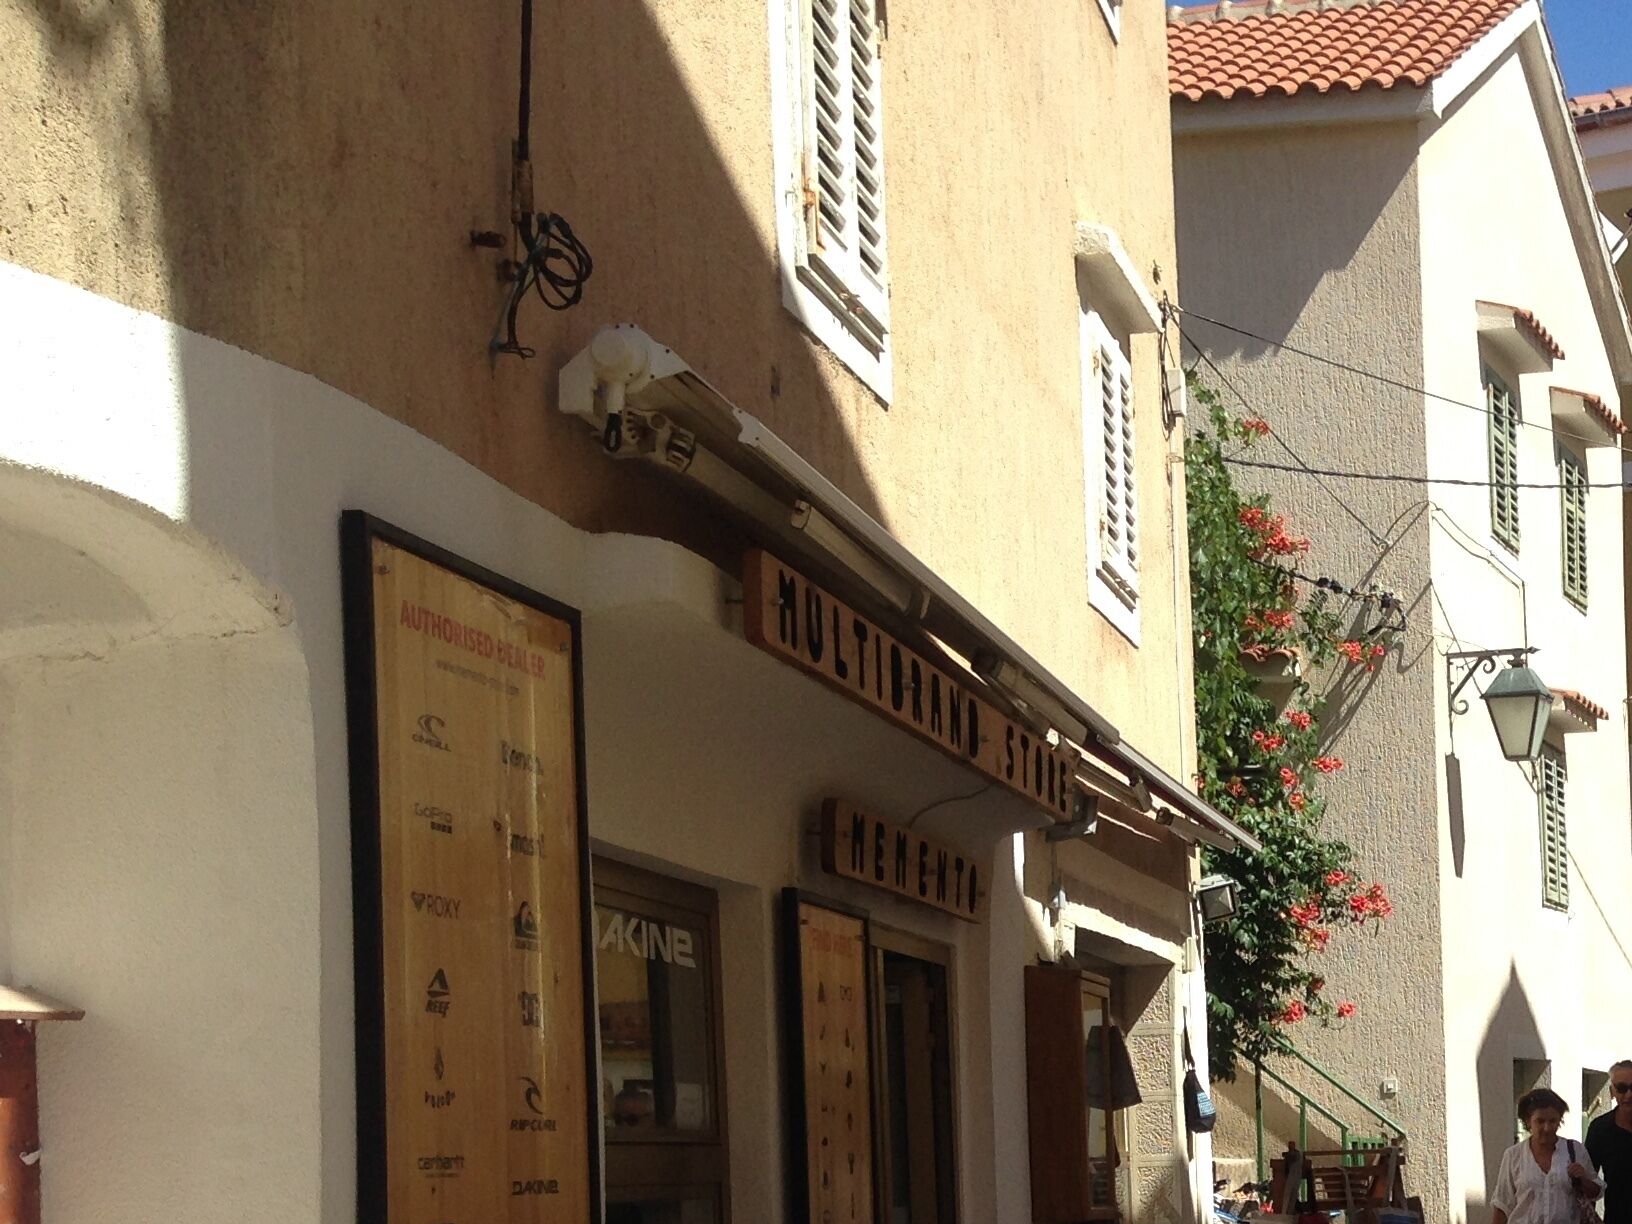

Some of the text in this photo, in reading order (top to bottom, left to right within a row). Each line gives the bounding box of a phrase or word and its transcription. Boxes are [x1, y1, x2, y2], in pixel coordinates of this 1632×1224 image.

[400, 599, 493, 660] AUTHORISED
[497, 638, 546, 681] DEALER
[779, 568, 1067, 813] MULTIBRAND STORE
[851, 811, 978, 914] MEMENTO
[427, 893, 461, 919] ROXY
[425, 999, 451, 1018] REEF
